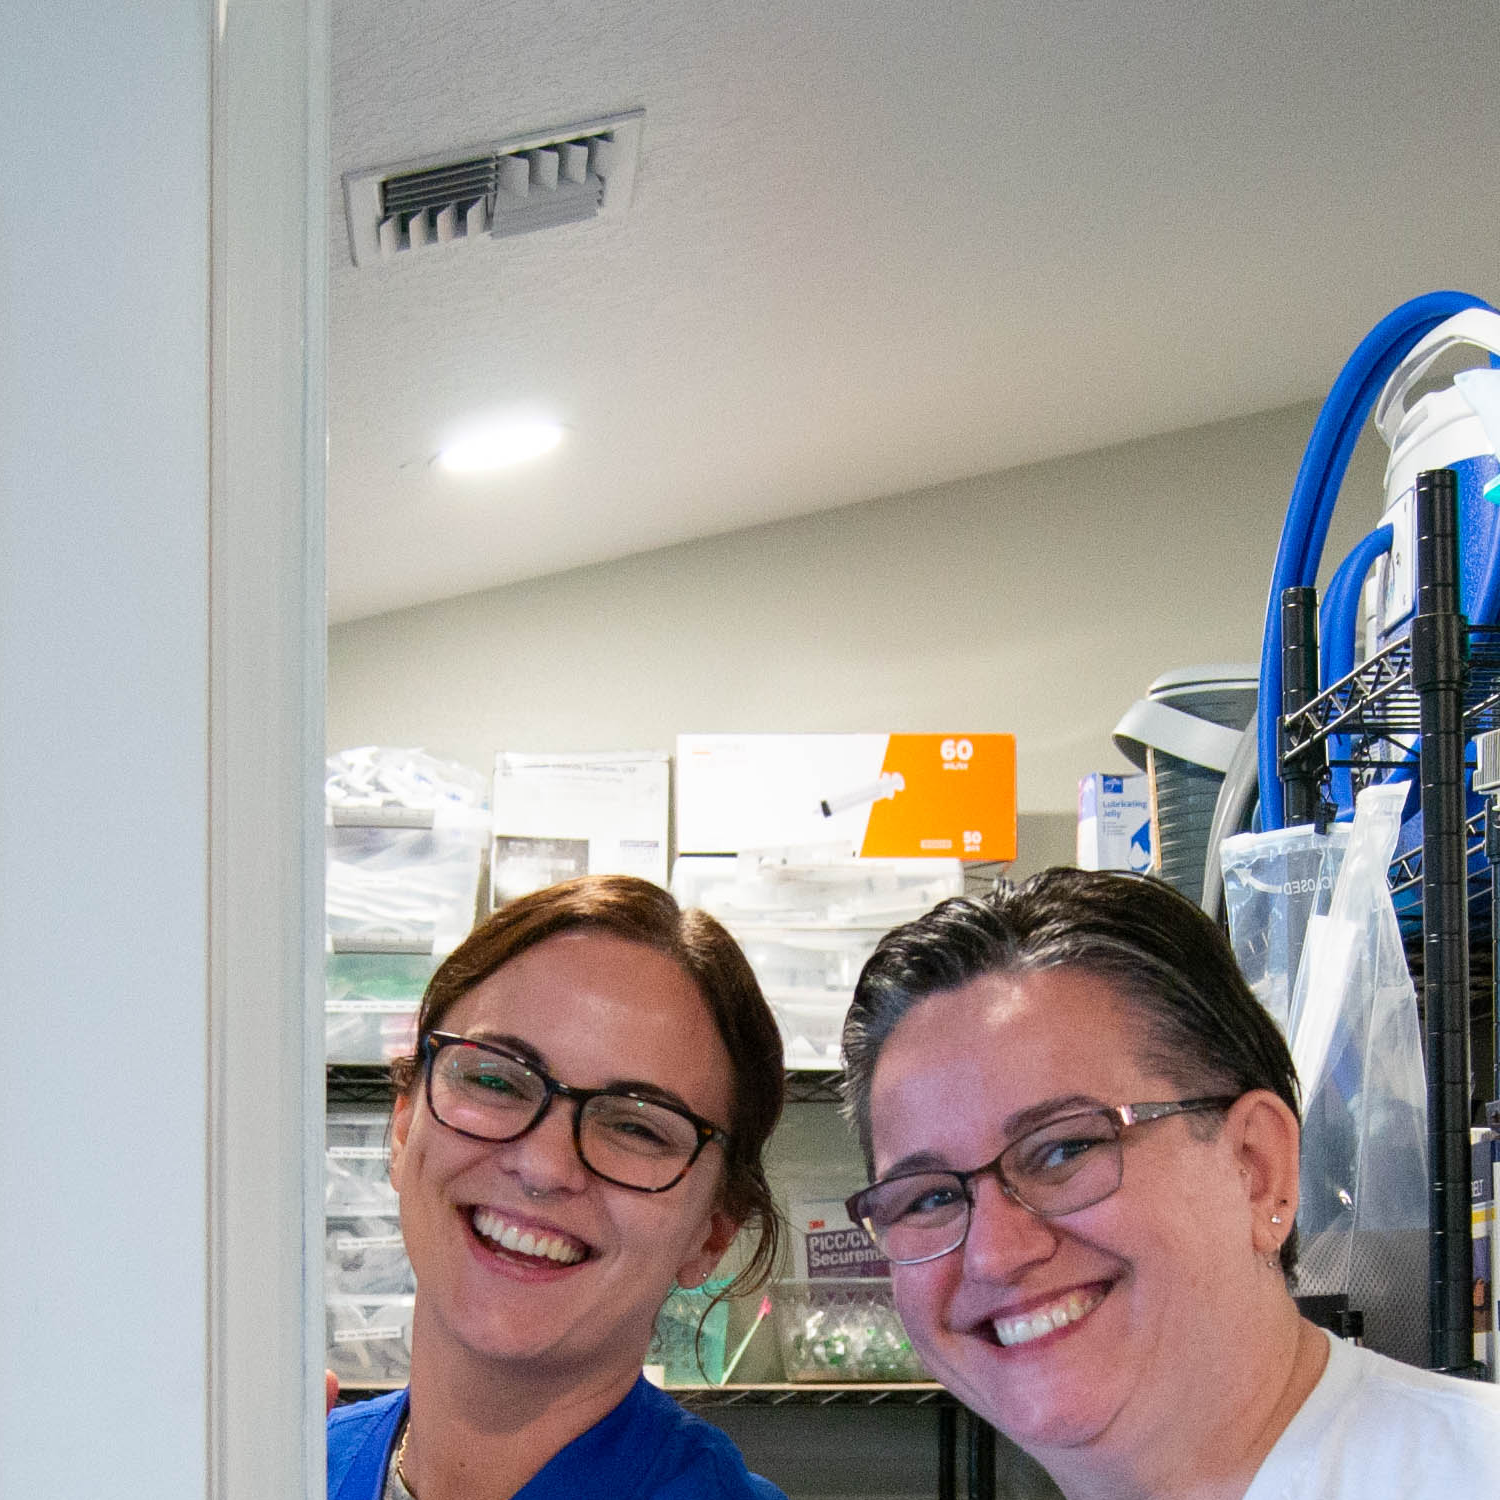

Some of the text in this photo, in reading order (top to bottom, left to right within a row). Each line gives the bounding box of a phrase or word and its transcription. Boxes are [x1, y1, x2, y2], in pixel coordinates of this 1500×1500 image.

[940, 740, 973, 761] 60
[963, 831, 981, 843] 50
[810, 1231, 869, 1251] PICC/CV
[811, 1249, 882, 1267] Securem
